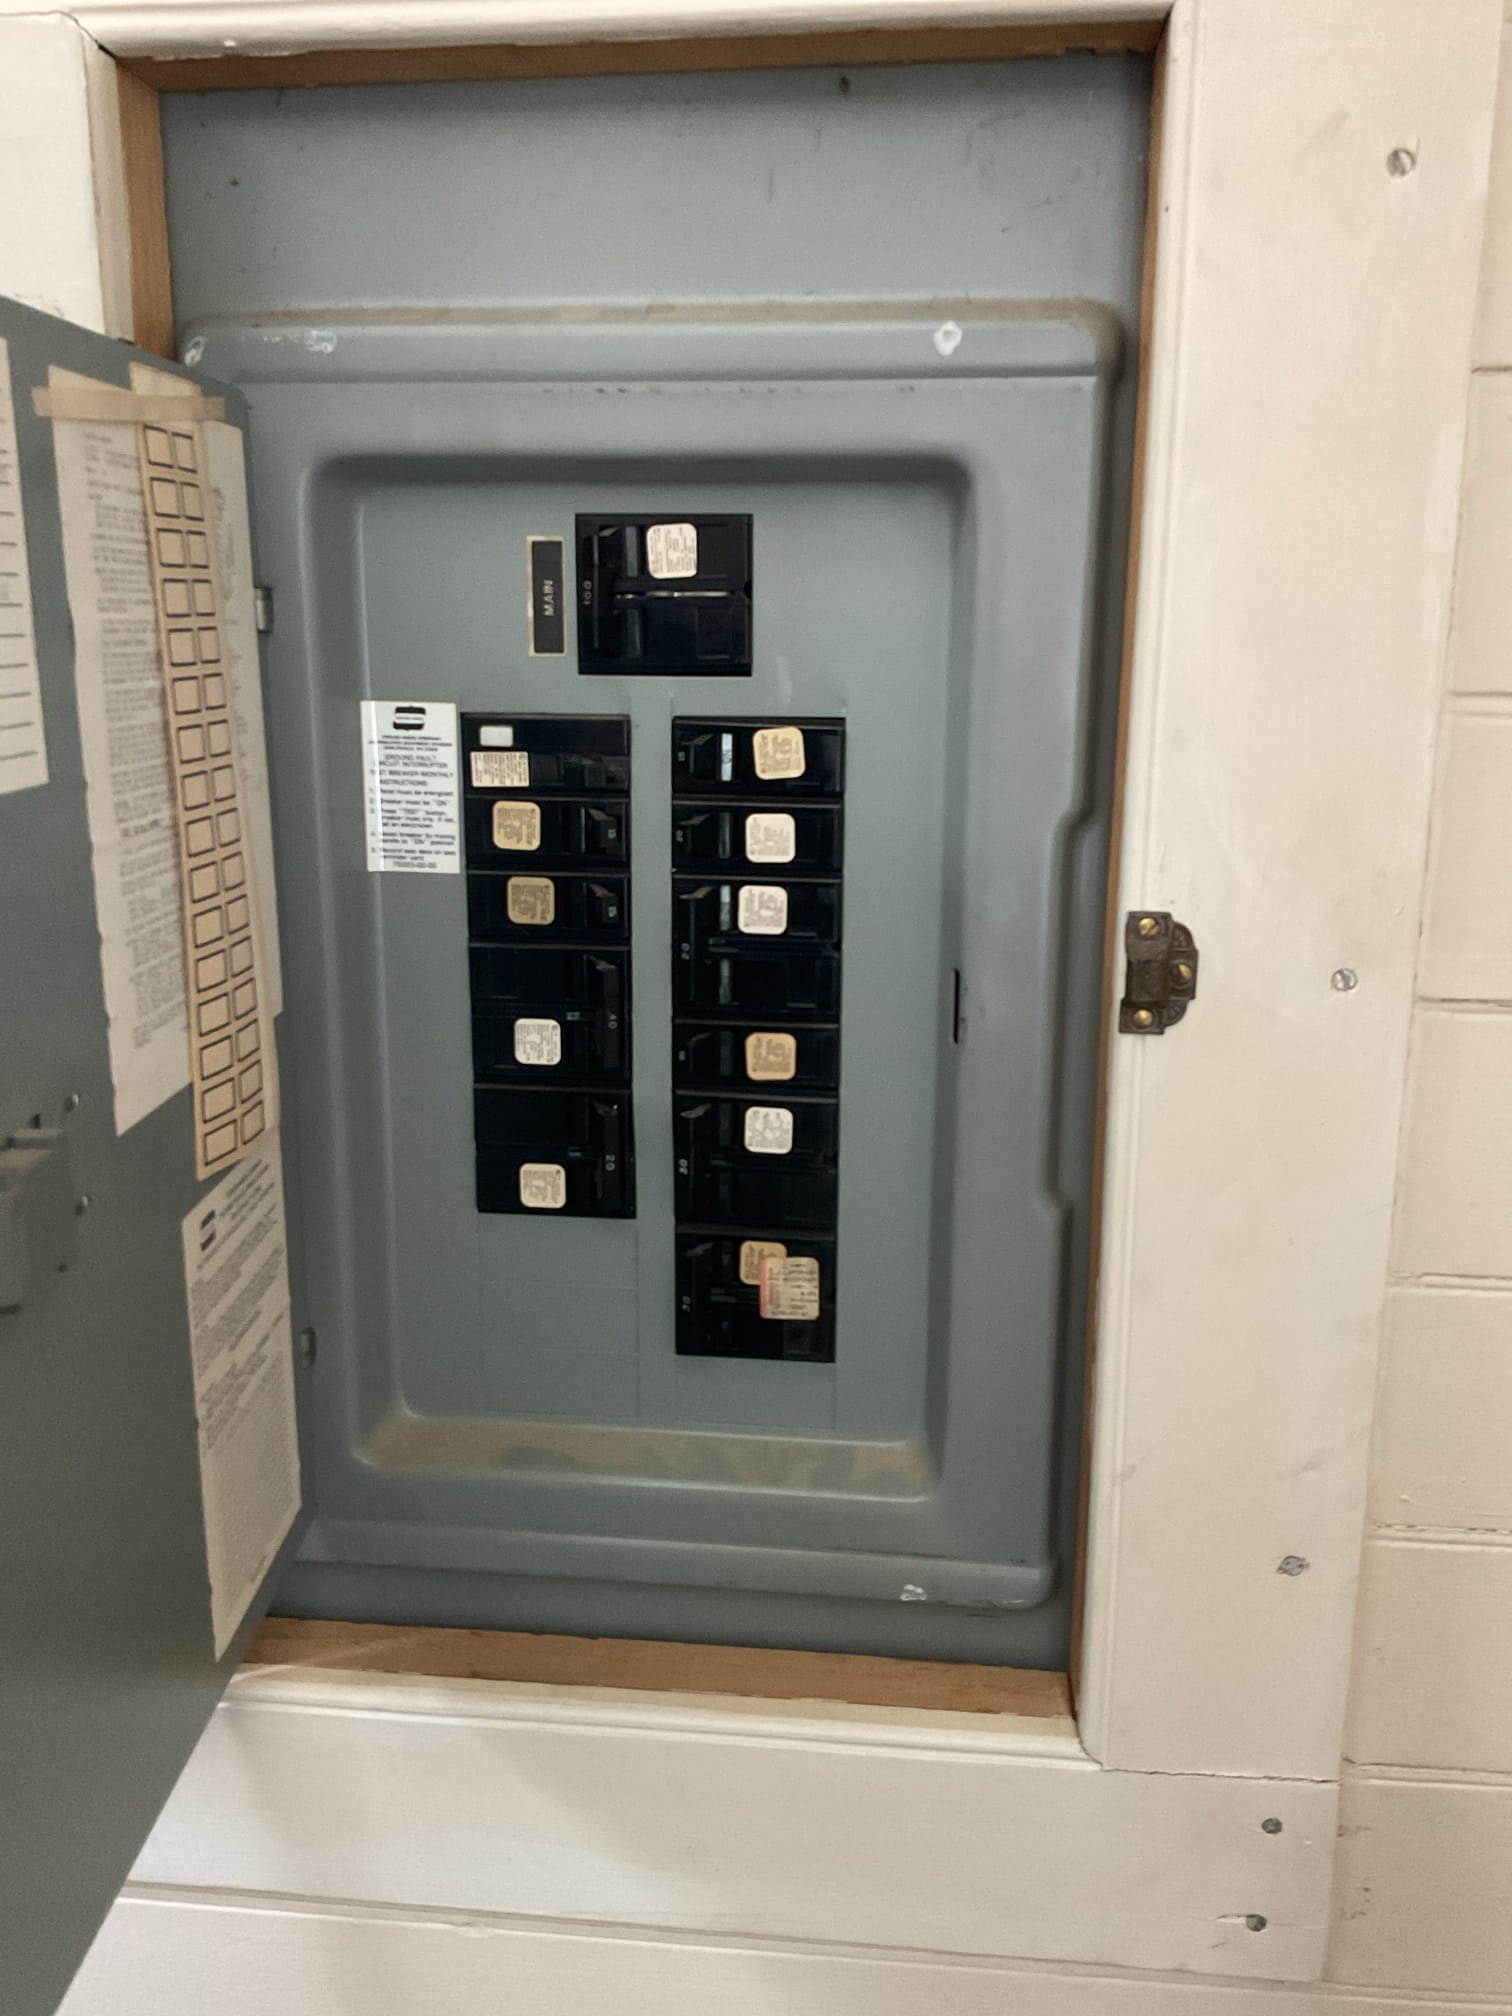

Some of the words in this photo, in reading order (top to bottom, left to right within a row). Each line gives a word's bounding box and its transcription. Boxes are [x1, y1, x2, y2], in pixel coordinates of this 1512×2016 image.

[543, 579, 554, 617] MAIN
[583, 580, 592, 606] 100
[607, 1014, 618, 1029] 40
[605, 1154, 616, 1171] 20
